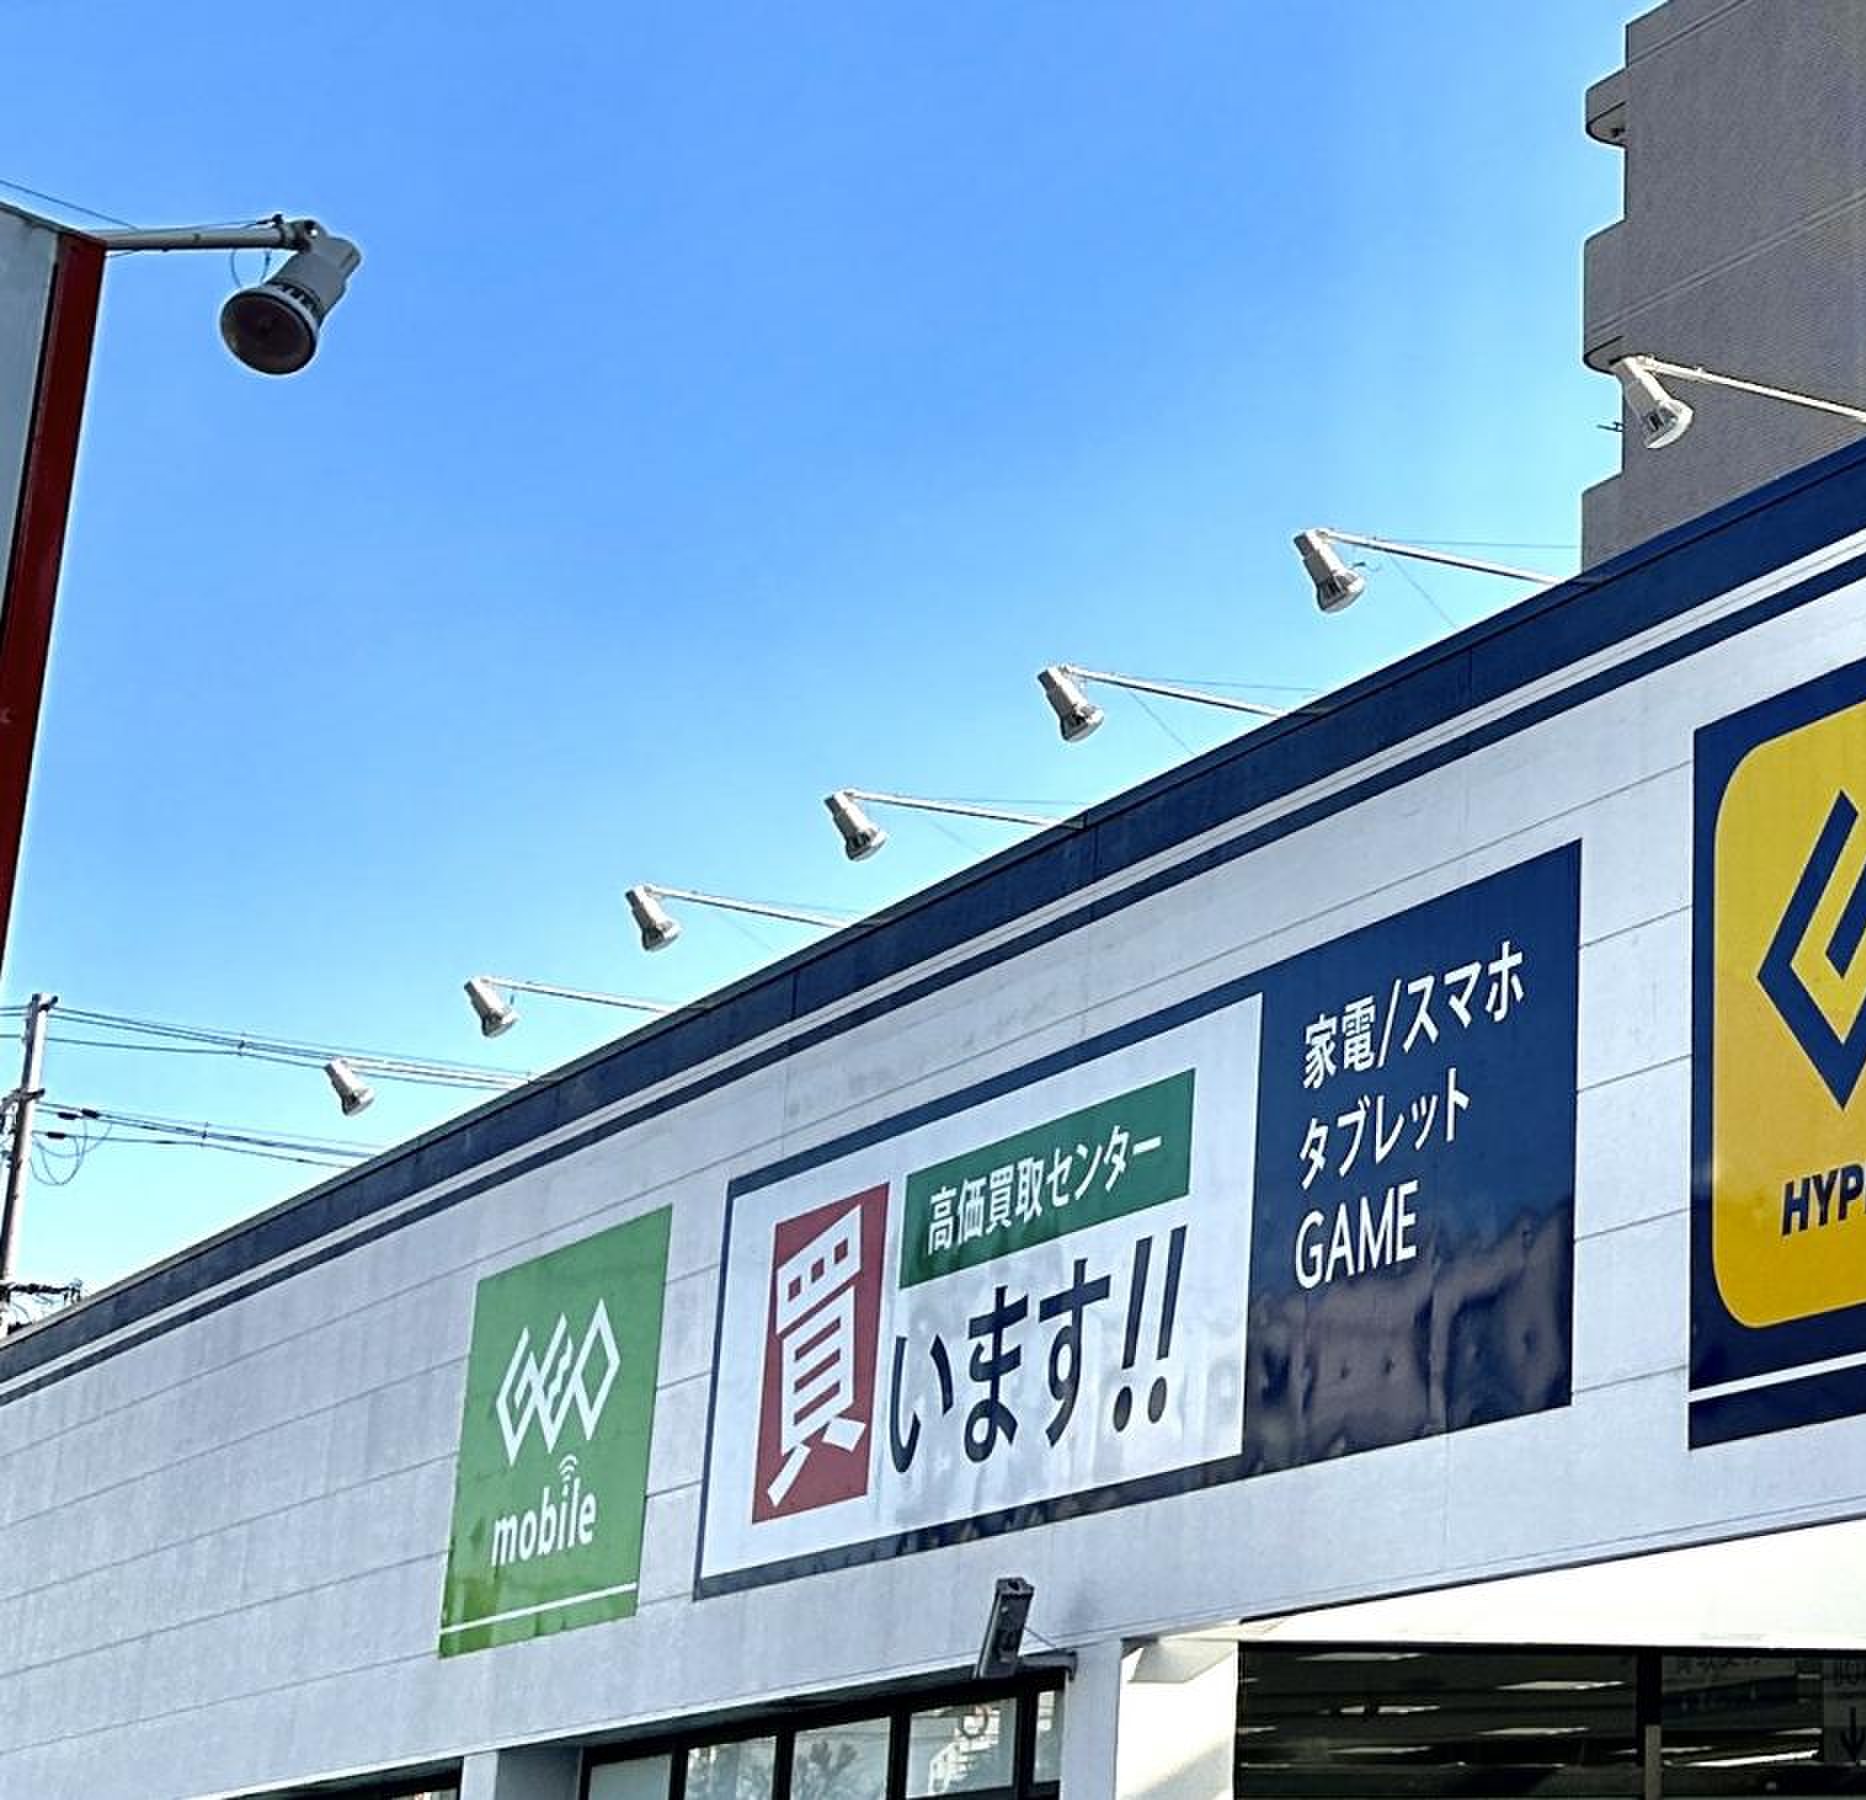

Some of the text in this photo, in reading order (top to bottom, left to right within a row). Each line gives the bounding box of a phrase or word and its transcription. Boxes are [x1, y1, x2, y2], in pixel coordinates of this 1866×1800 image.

[1303, 940, 1525, 1090] 家電/スマホ
[1299, 1067, 1470, 1190] タブレット
[927, 1124, 1163, 1257] 高価買取センター
[1294, 1180, 1418, 1289] GAME
[490, 1477, 598, 1567] mobile
